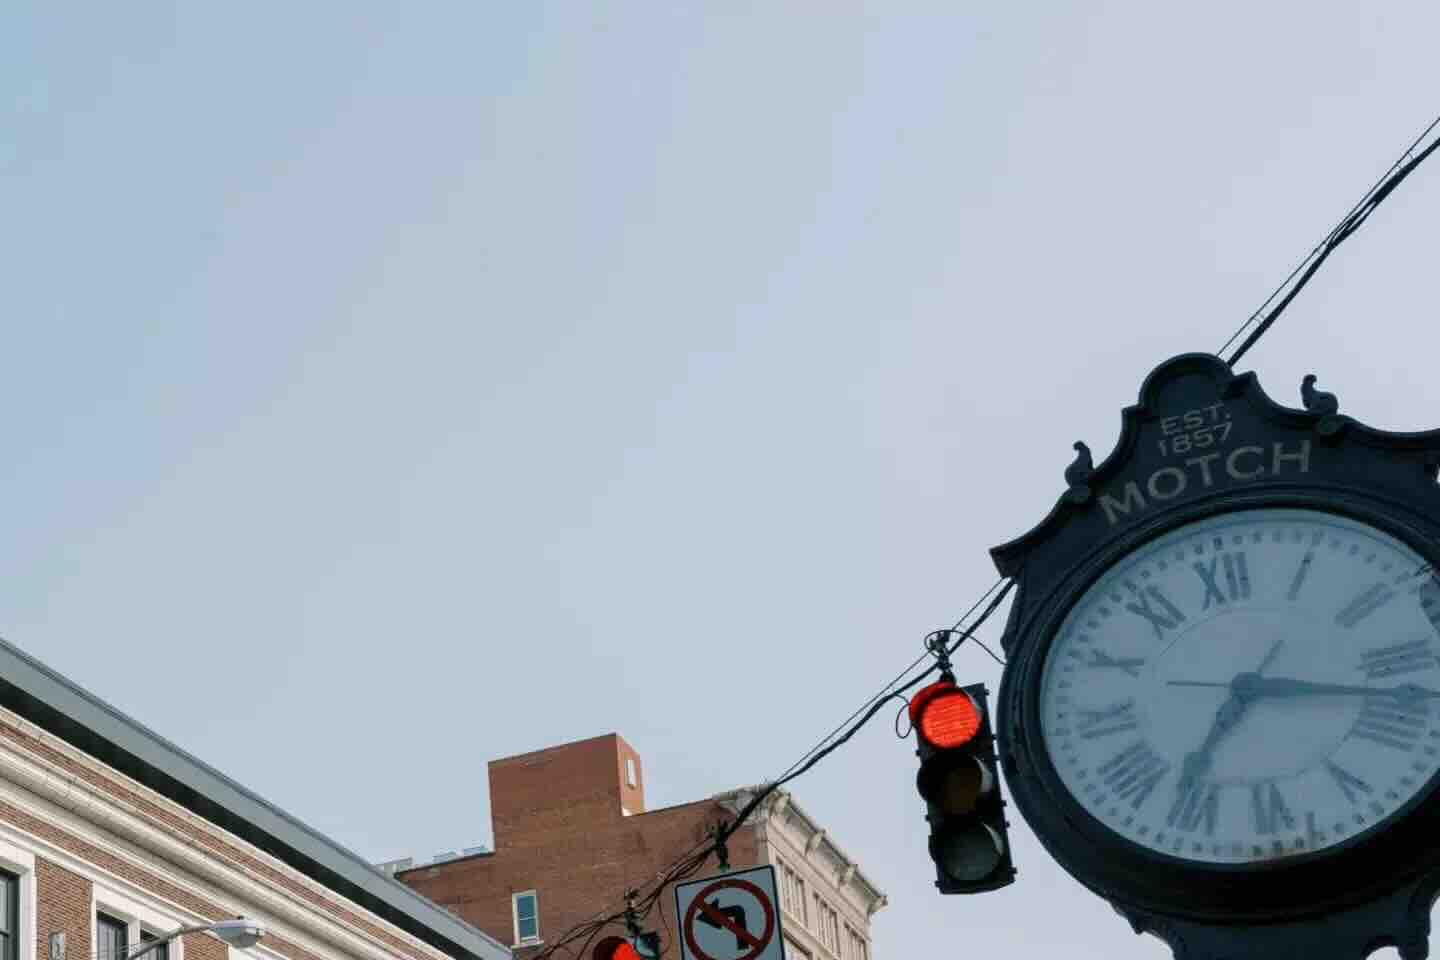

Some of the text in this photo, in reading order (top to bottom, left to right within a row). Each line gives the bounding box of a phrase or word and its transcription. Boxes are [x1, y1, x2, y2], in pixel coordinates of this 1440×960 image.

[1158, 421, 1233, 457] 1857
[1161, 402, 1231, 435] EST.
[1098, 439, 1311, 524] MOTCH
[1193, 551, 1251, 611] XII
[1333, 581, 1396, 629] II
[1125, 583, 1186, 641] XI
[1087, 648, 1145, 679] X
